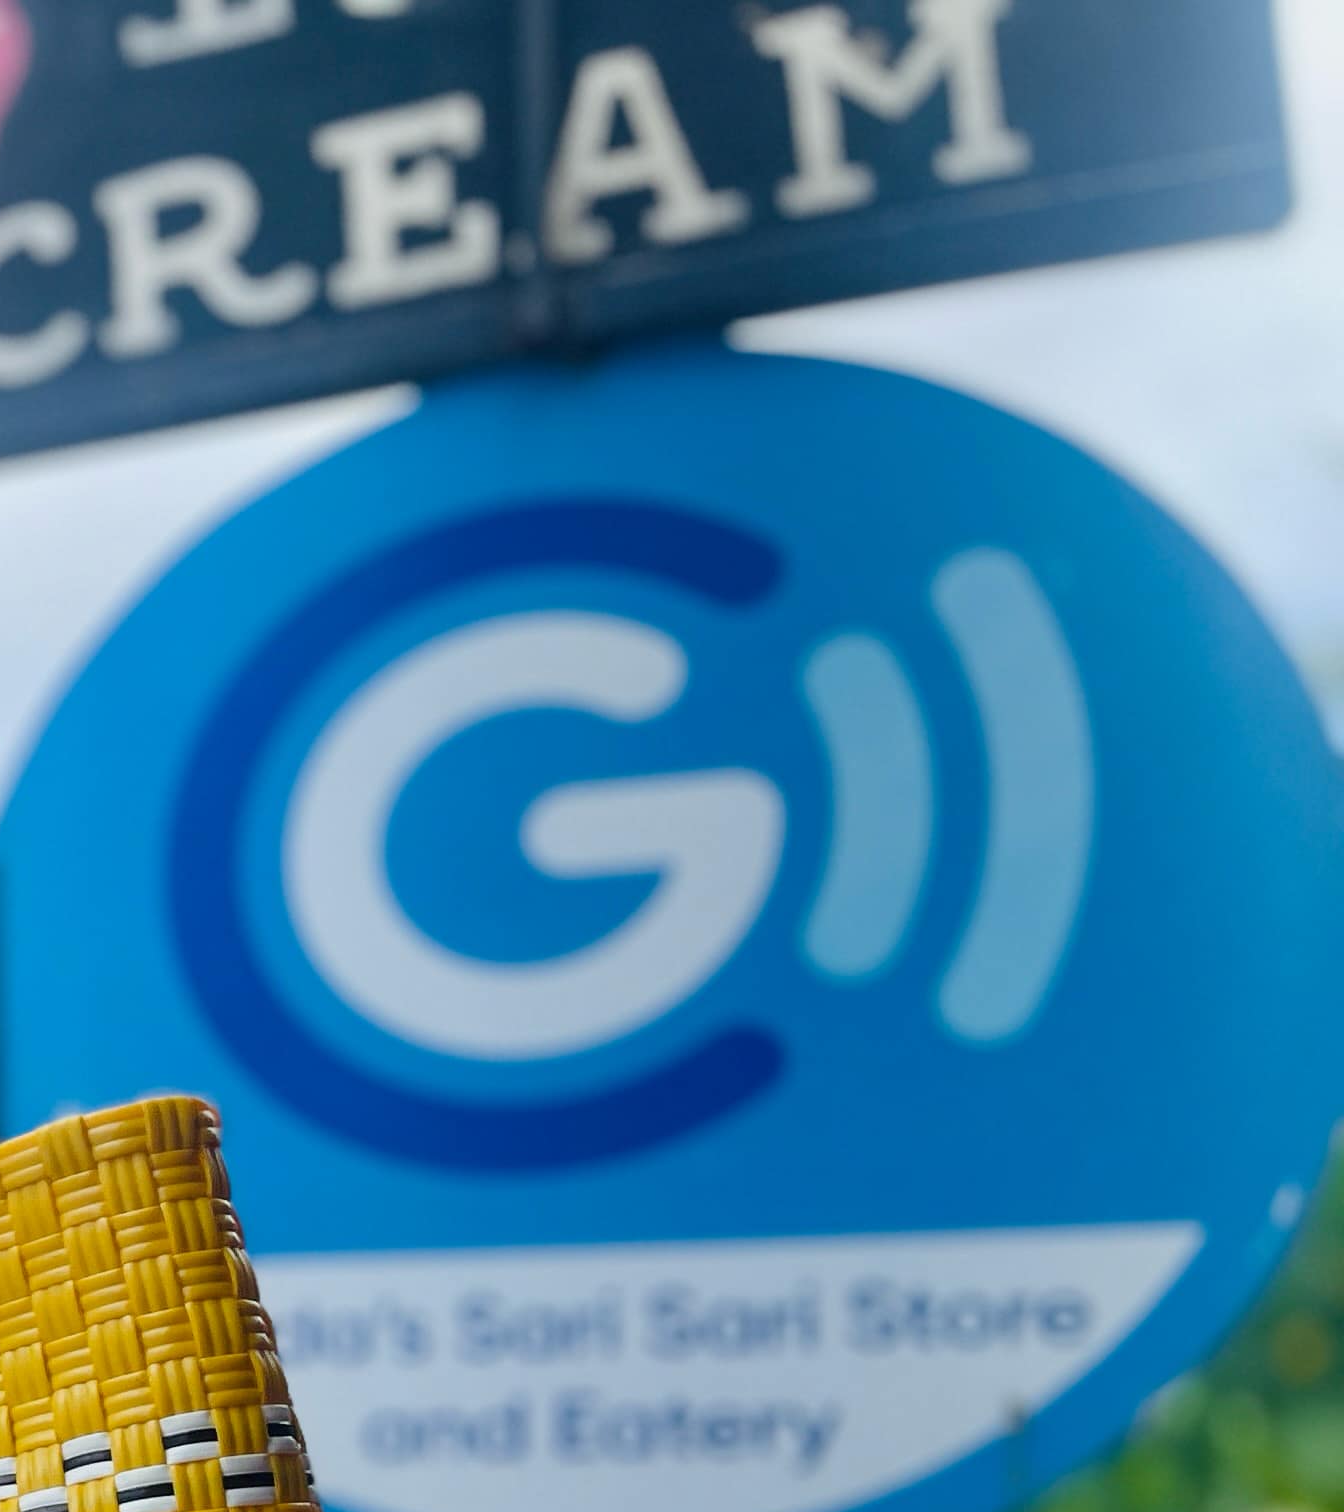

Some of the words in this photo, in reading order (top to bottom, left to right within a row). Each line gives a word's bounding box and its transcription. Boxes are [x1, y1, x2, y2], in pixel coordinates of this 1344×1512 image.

[454, 1285, 624, 1366] Sari
[644, 1279, 820, 1359] Sari
[846, 1276, 1094, 1354] Store
[360, 1390, 530, 1464] and
[552, 1388, 844, 1480] Eatery
